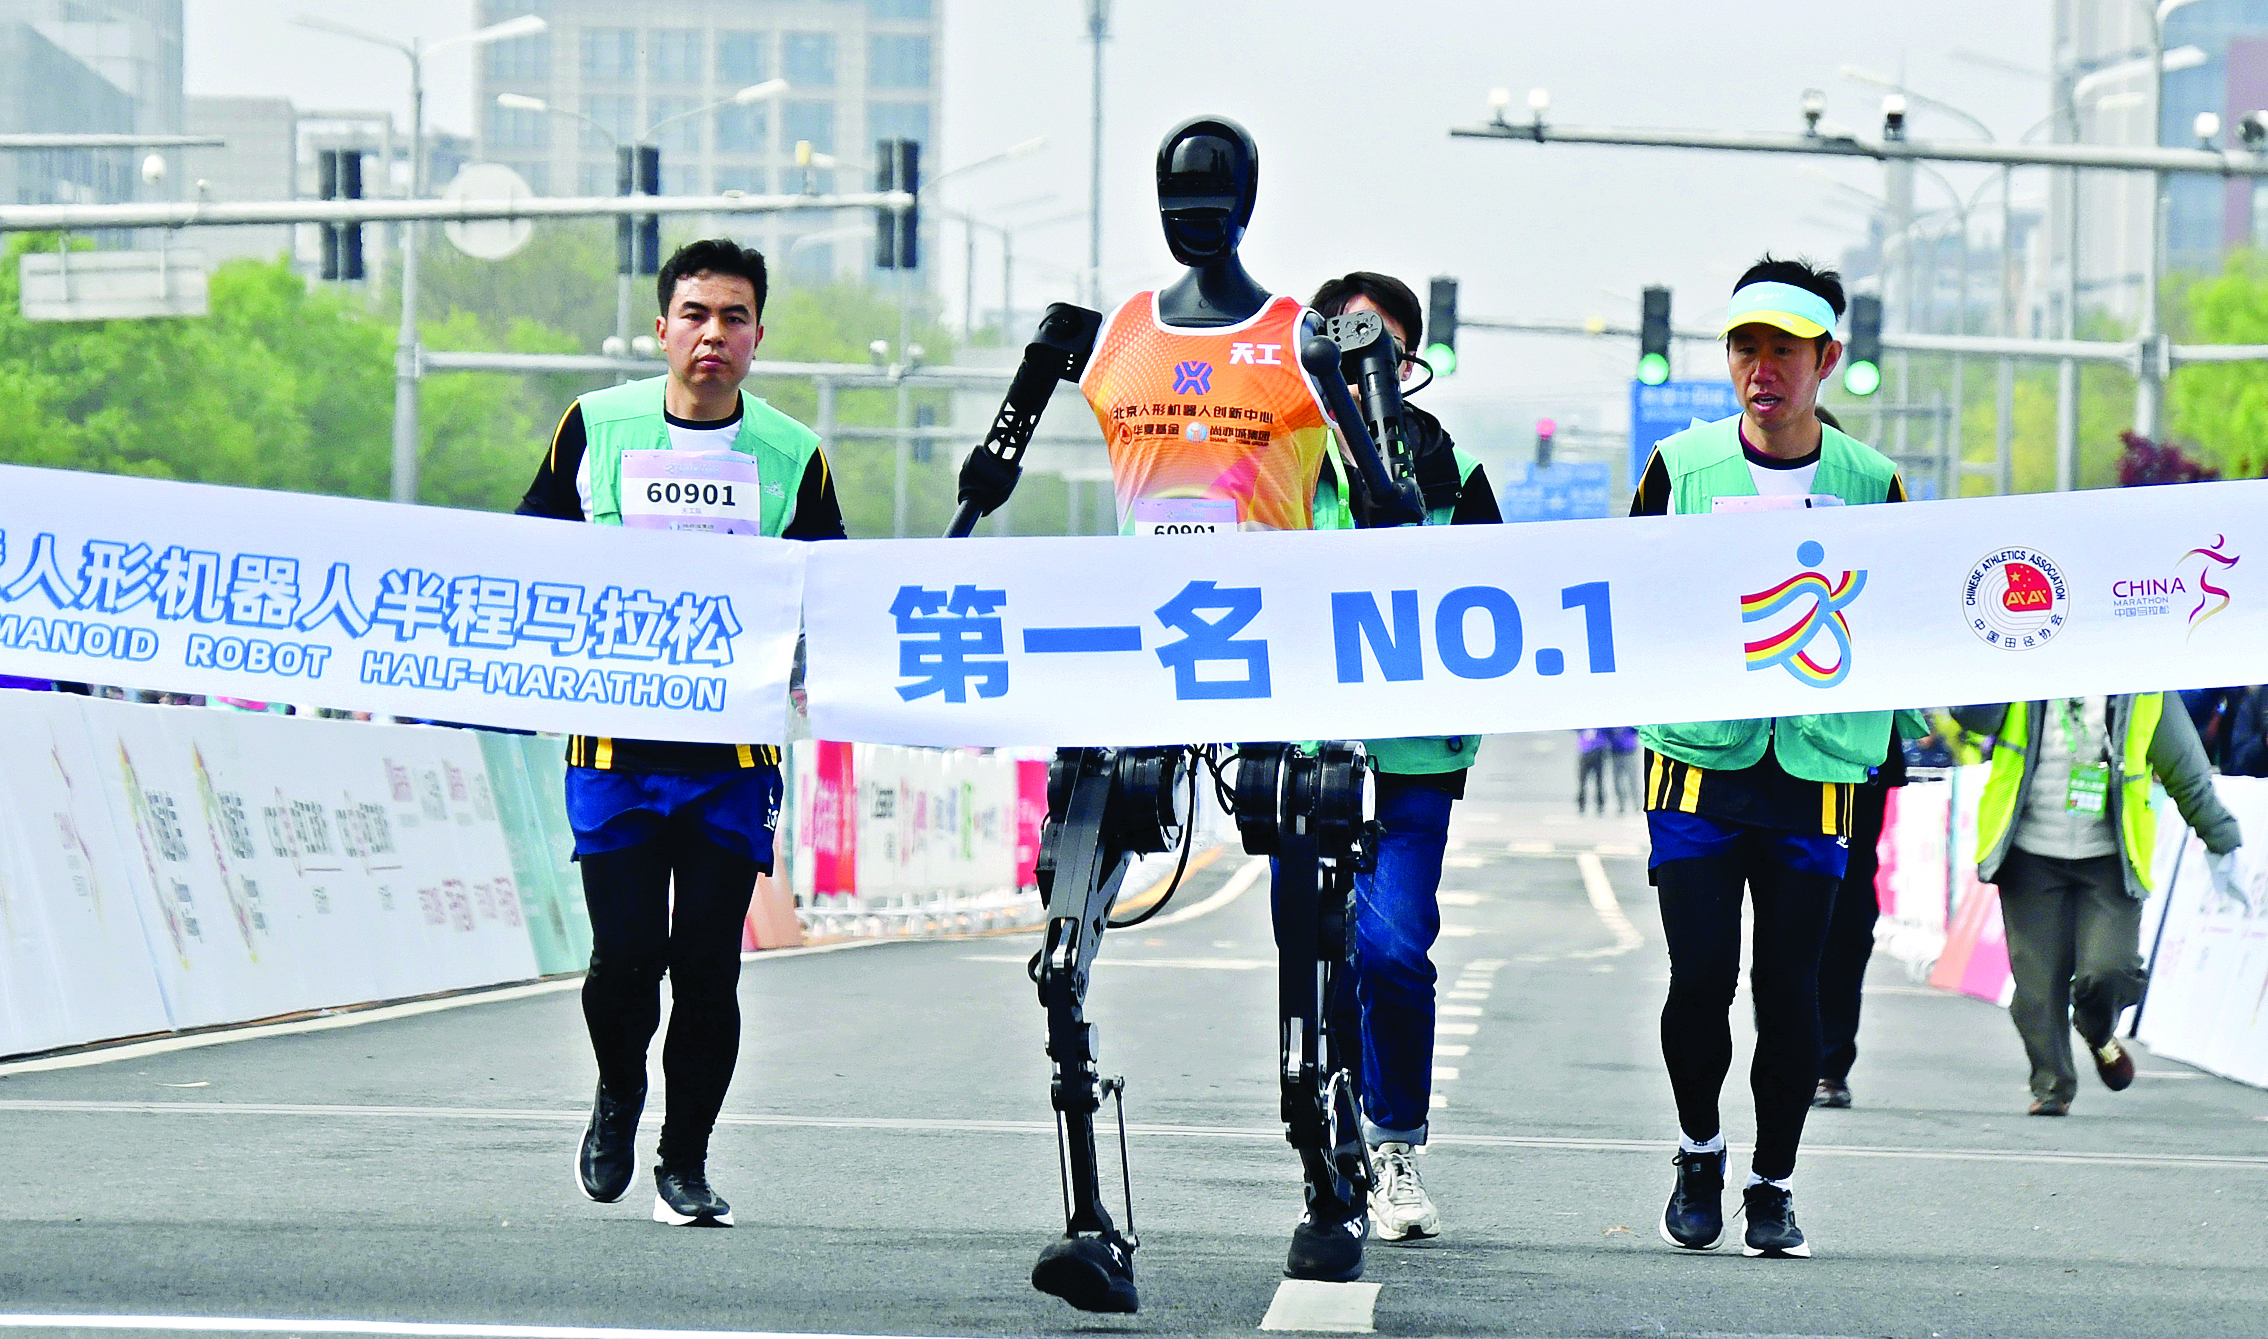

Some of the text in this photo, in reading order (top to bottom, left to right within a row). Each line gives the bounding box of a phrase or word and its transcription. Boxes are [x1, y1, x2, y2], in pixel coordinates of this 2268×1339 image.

[1229, 341, 1282, 365] 天工
[1113, 403, 1274, 425] 北京人形机器人创新中心
[646, 481, 736, 507] 60901
[1966, 550, 2066, 606] CHINESE ATHLETICS ASSOCIATION
[2112, 577, 2186, 598] CHINA
[0, 529, 743, 668] 人形机器人半程马拉松
[2113, 596, 2169, 606] MARATHON
[888, 580, 1617, 704] 第一名 NO.1
[1974, 613, 2063, 649] 中国田径协会
[185, 633, 332, 678] ROBOT
[360, 650, 727, 712] HALF-MARATHON
